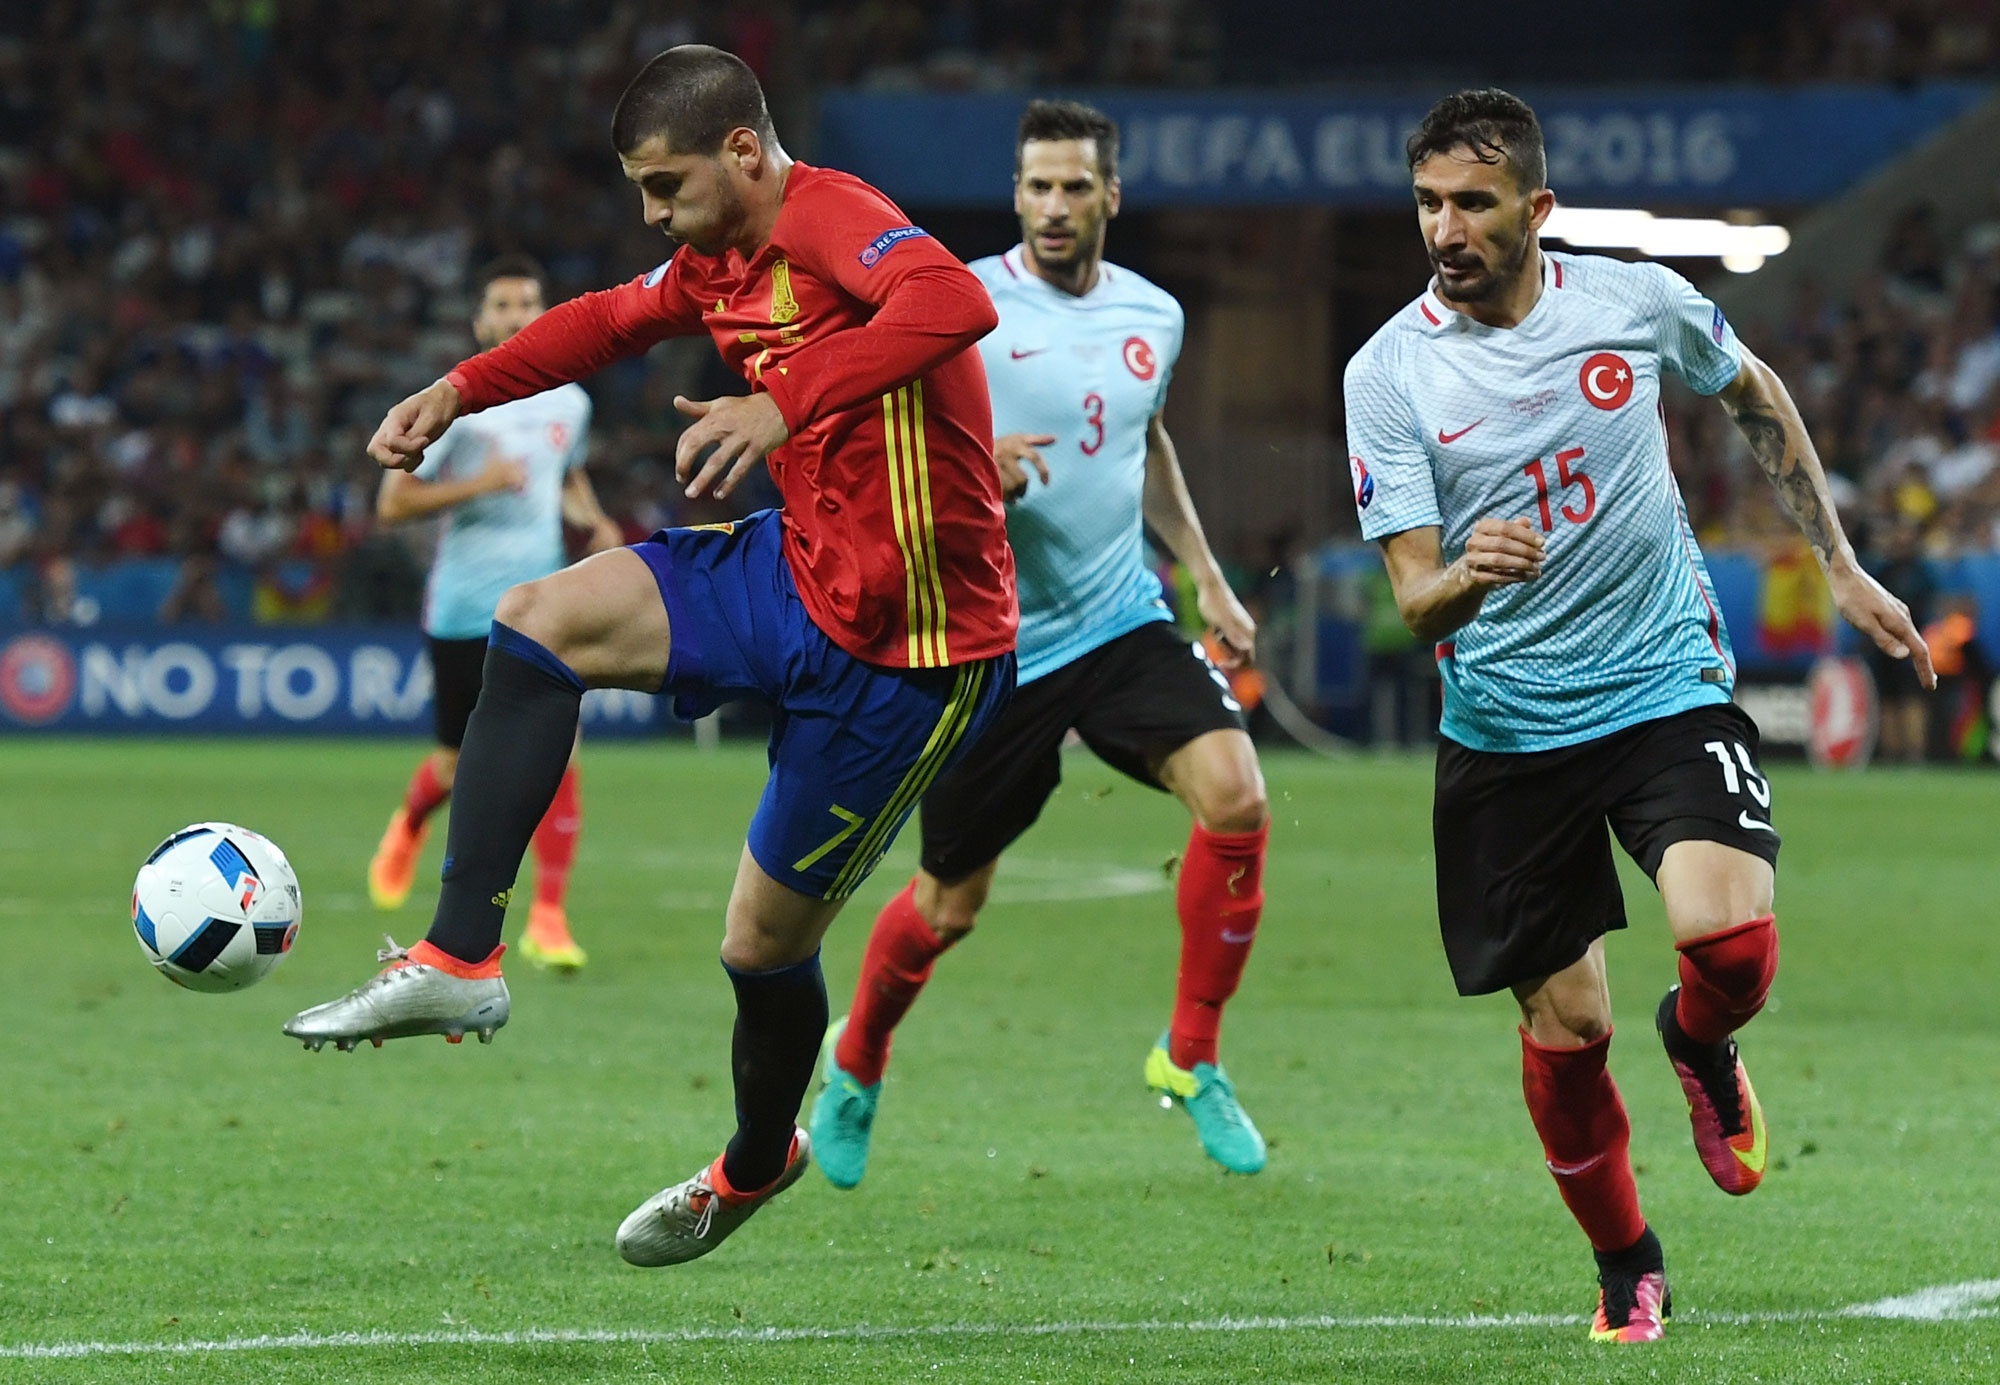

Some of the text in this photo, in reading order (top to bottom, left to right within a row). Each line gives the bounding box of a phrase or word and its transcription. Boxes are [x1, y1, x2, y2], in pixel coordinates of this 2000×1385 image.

[1315, 113, 1424, 185] EU
[1548, 113, 1735, 185] 2016
[876, 228, 925, 250] RESPECT
[1080, 392, 1105, 456] 3
[1524, 446, 1596, 532] 15
[81, 643, 217, 720] NO
[224, 643, 338, 720] TO
[792, 804, 865, 873] 7
